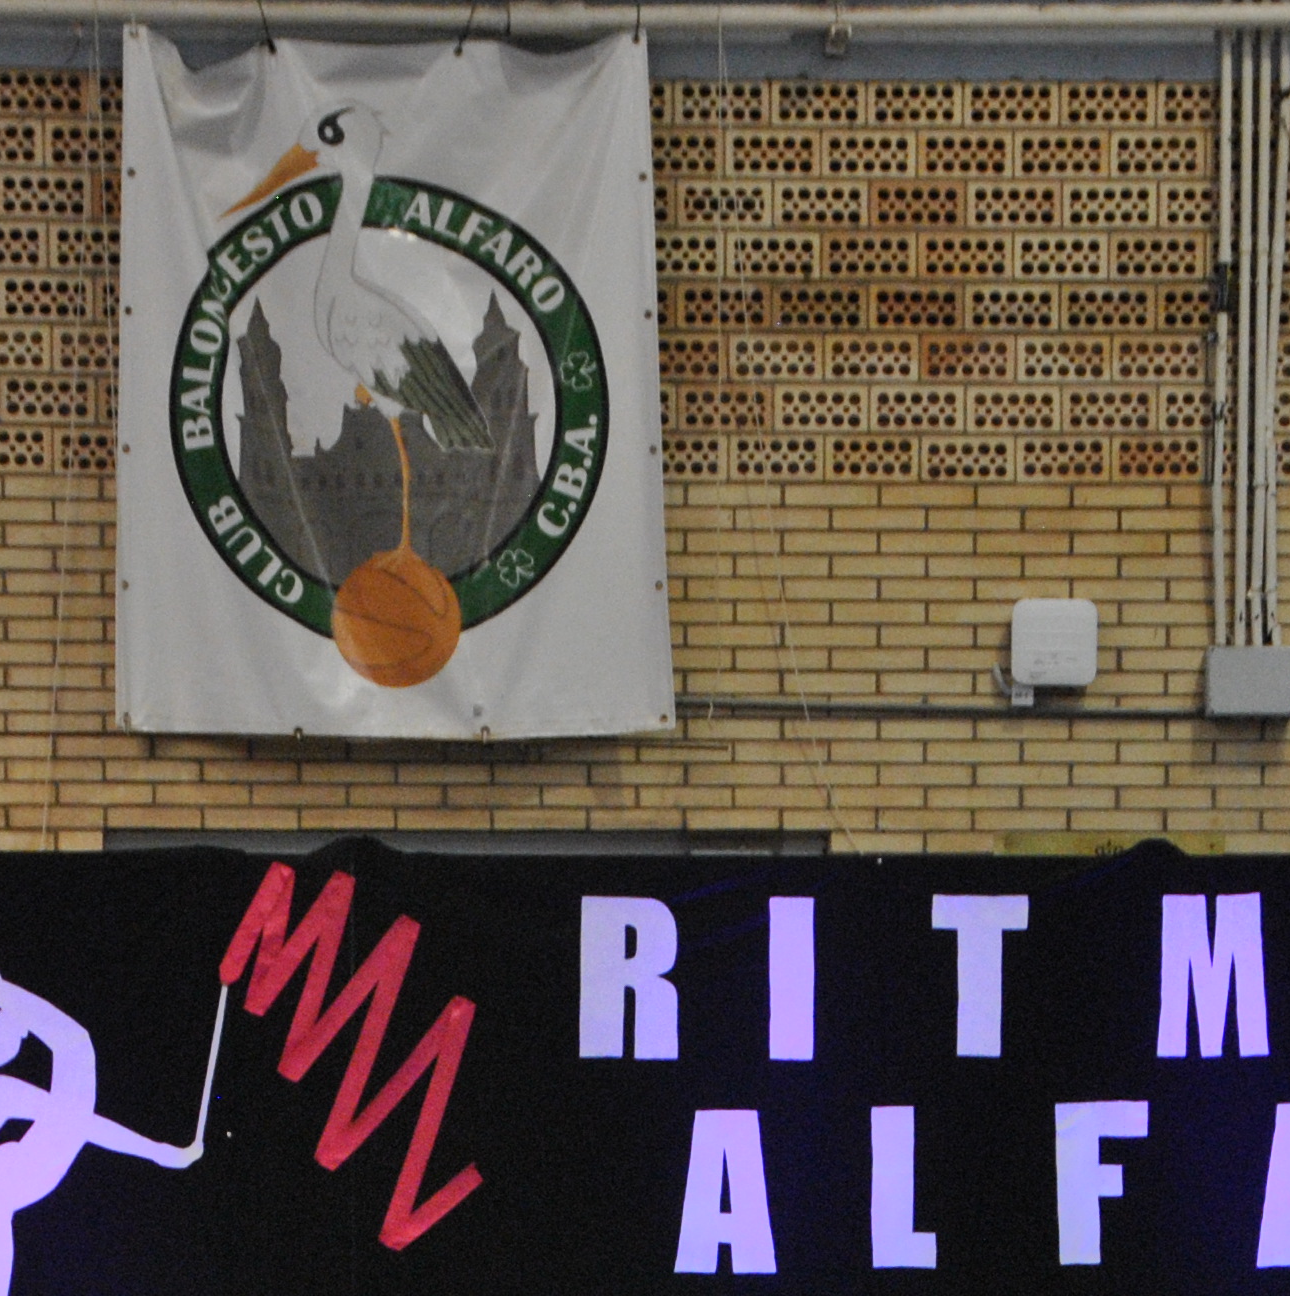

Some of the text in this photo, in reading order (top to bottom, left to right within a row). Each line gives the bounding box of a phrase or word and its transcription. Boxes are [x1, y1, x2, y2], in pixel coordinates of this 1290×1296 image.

[208, 495, 304, 603] CLUB
[402, 191, 566, 312] ALFARO
[537, 414, 598, 537] C.B.A.
